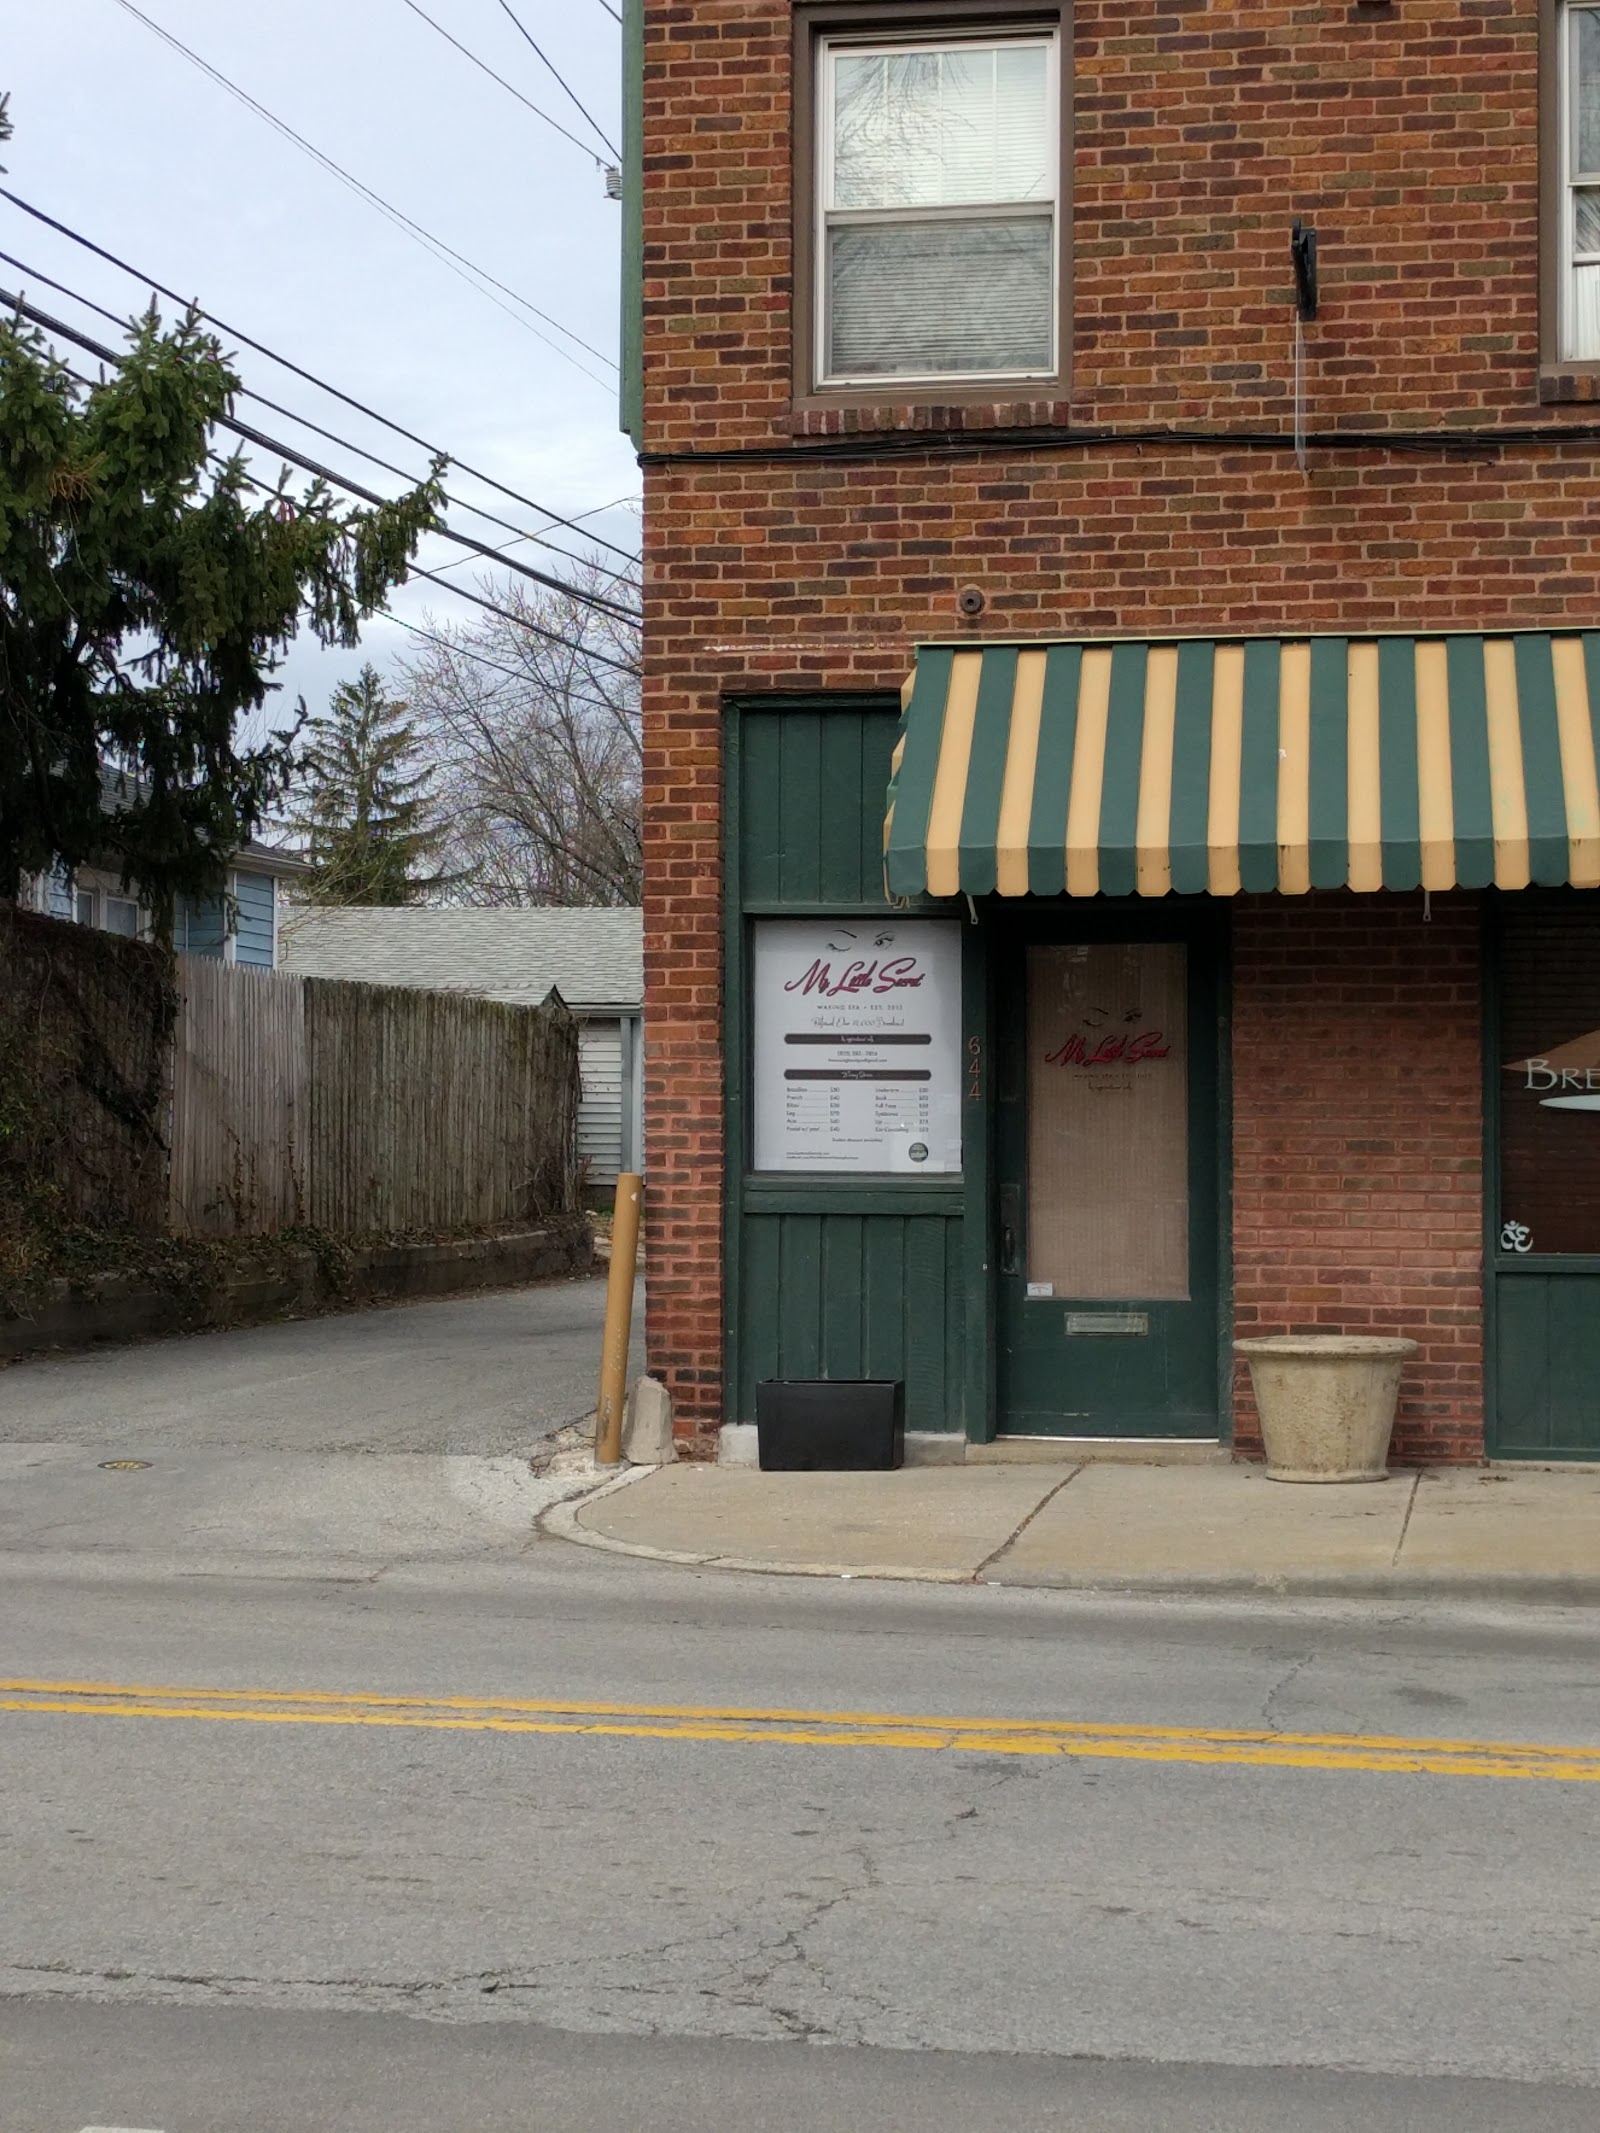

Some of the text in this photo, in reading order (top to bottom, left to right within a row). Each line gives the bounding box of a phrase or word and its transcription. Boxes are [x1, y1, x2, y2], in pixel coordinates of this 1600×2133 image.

[784, 957, 926, 997] My Little Secret
[1044, 1031, 1172, 1067] My Little Secret
